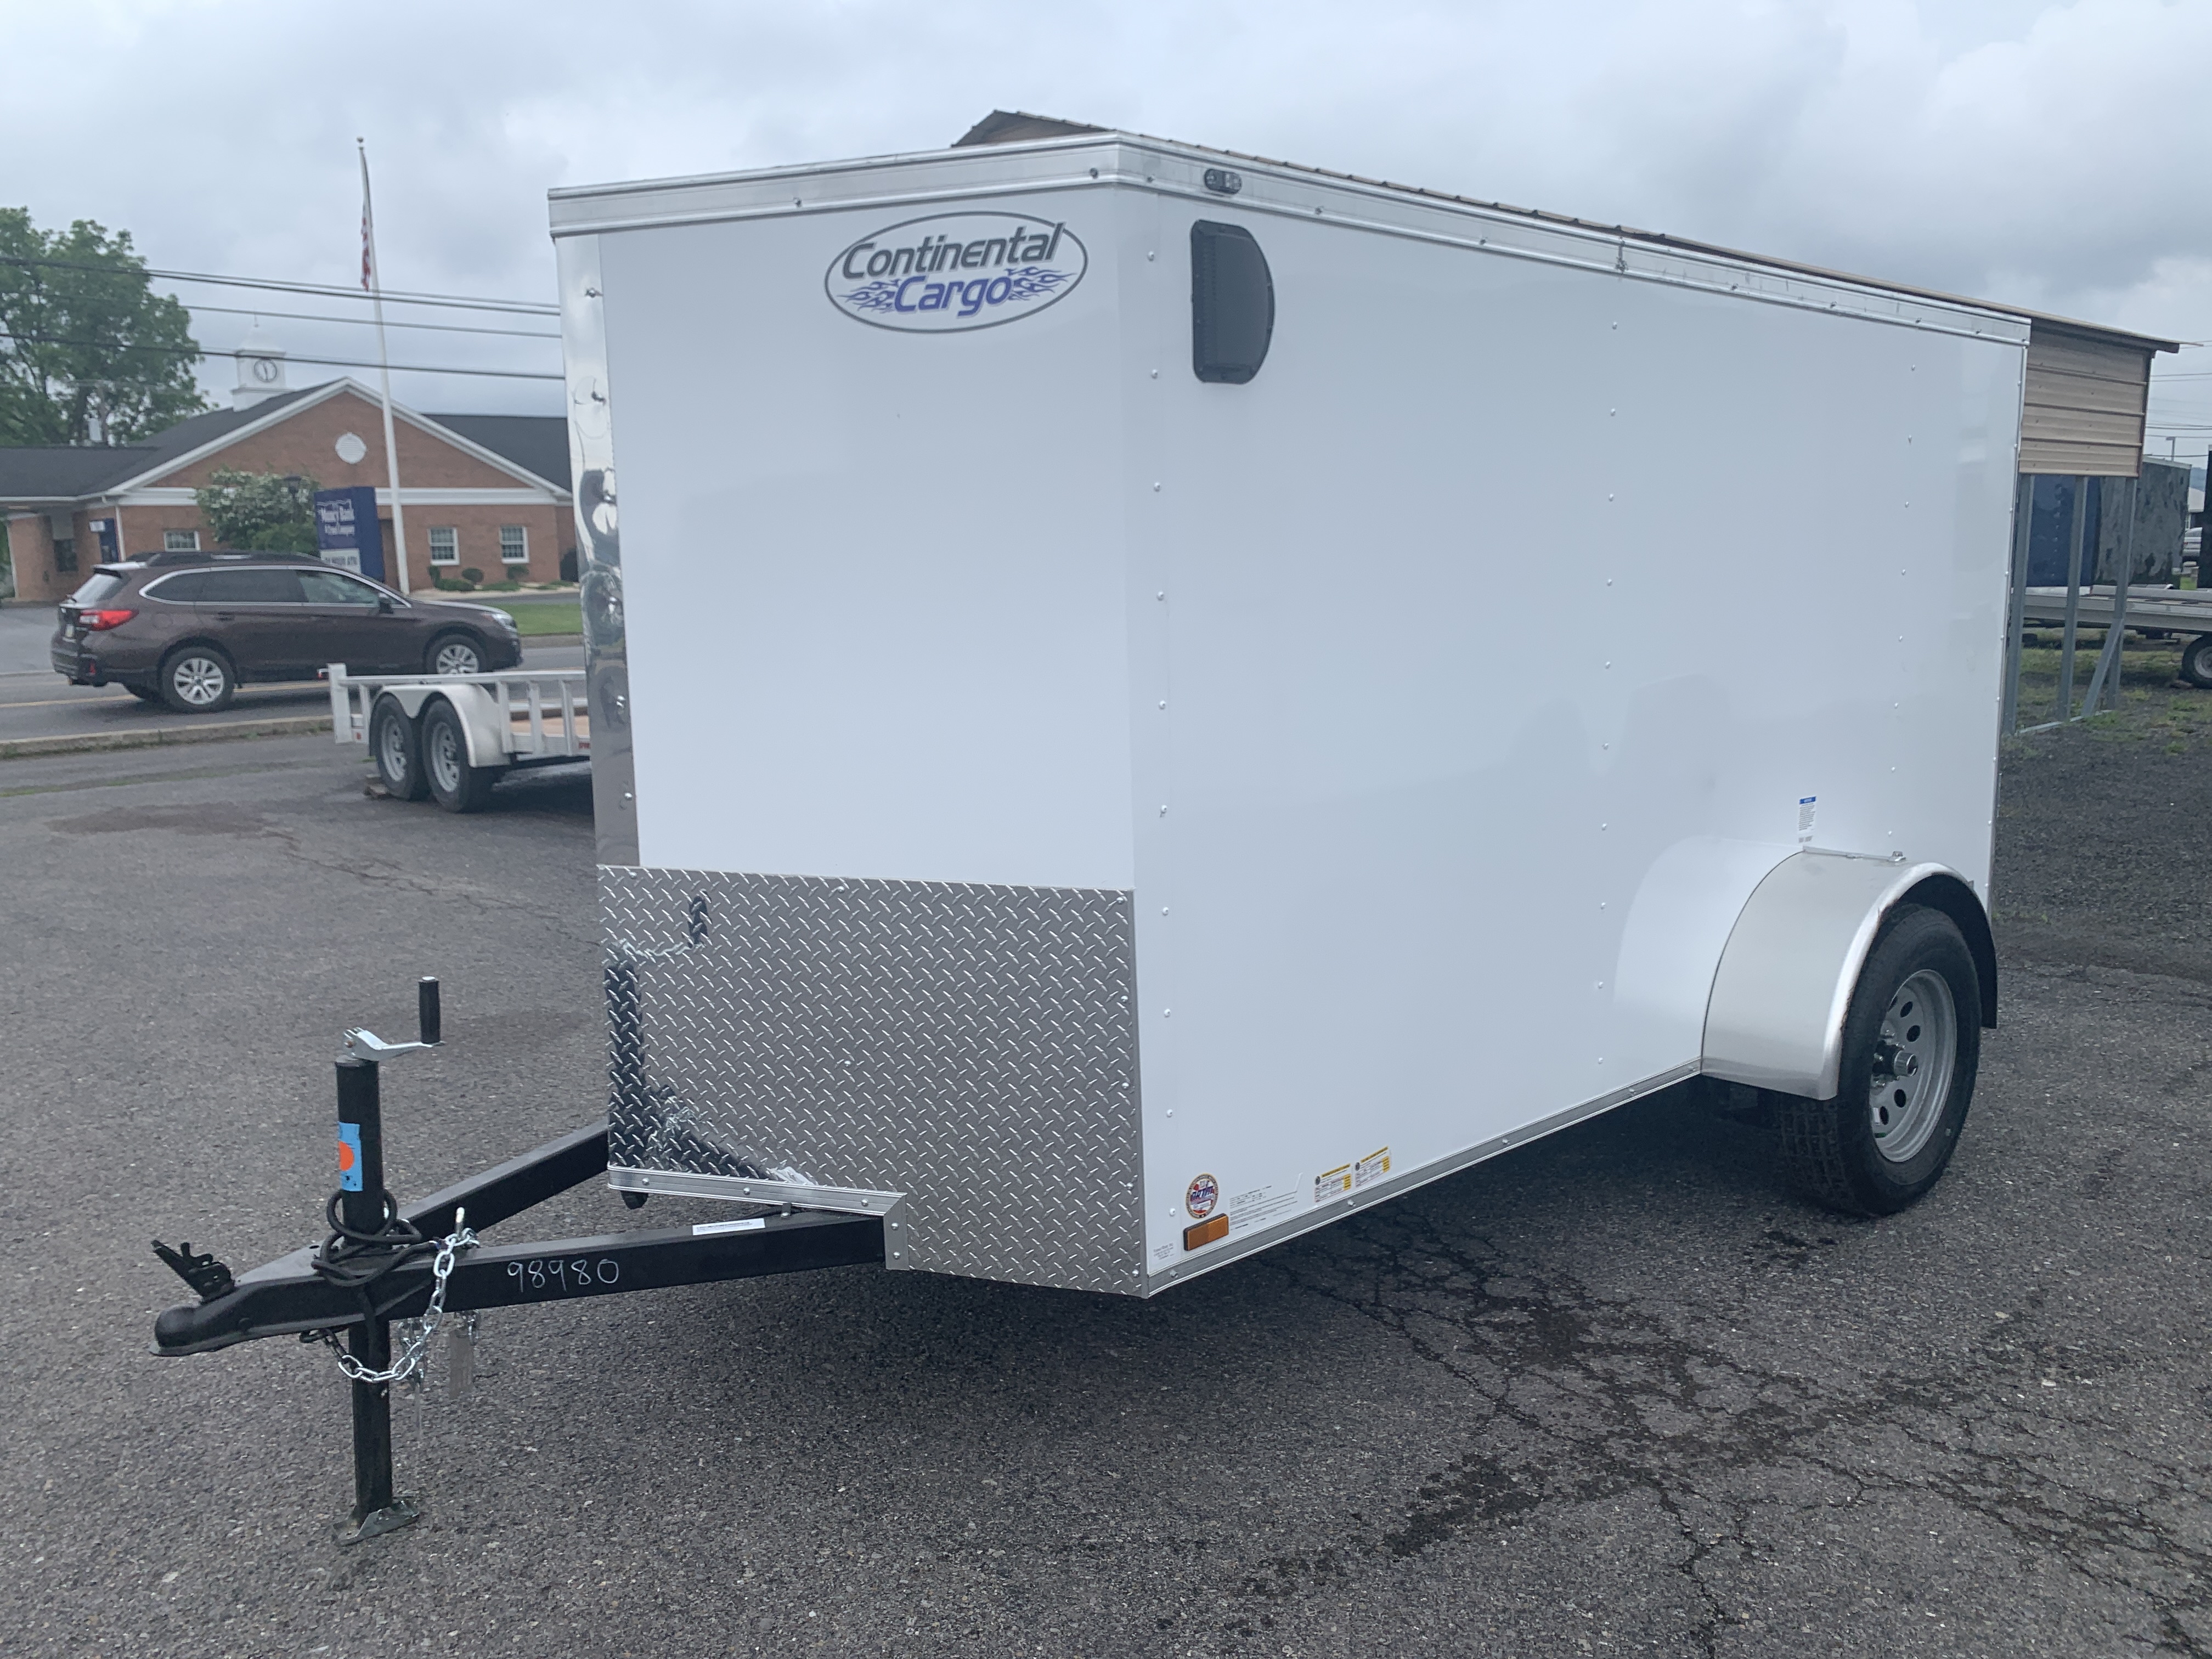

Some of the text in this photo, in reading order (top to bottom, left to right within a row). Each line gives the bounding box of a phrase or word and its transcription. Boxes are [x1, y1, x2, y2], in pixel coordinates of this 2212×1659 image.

[843, 222, 1065, 279] Continental
[894, 275, 1012, 317] Cargo
[507, 1259, 619, 1293] 98980
